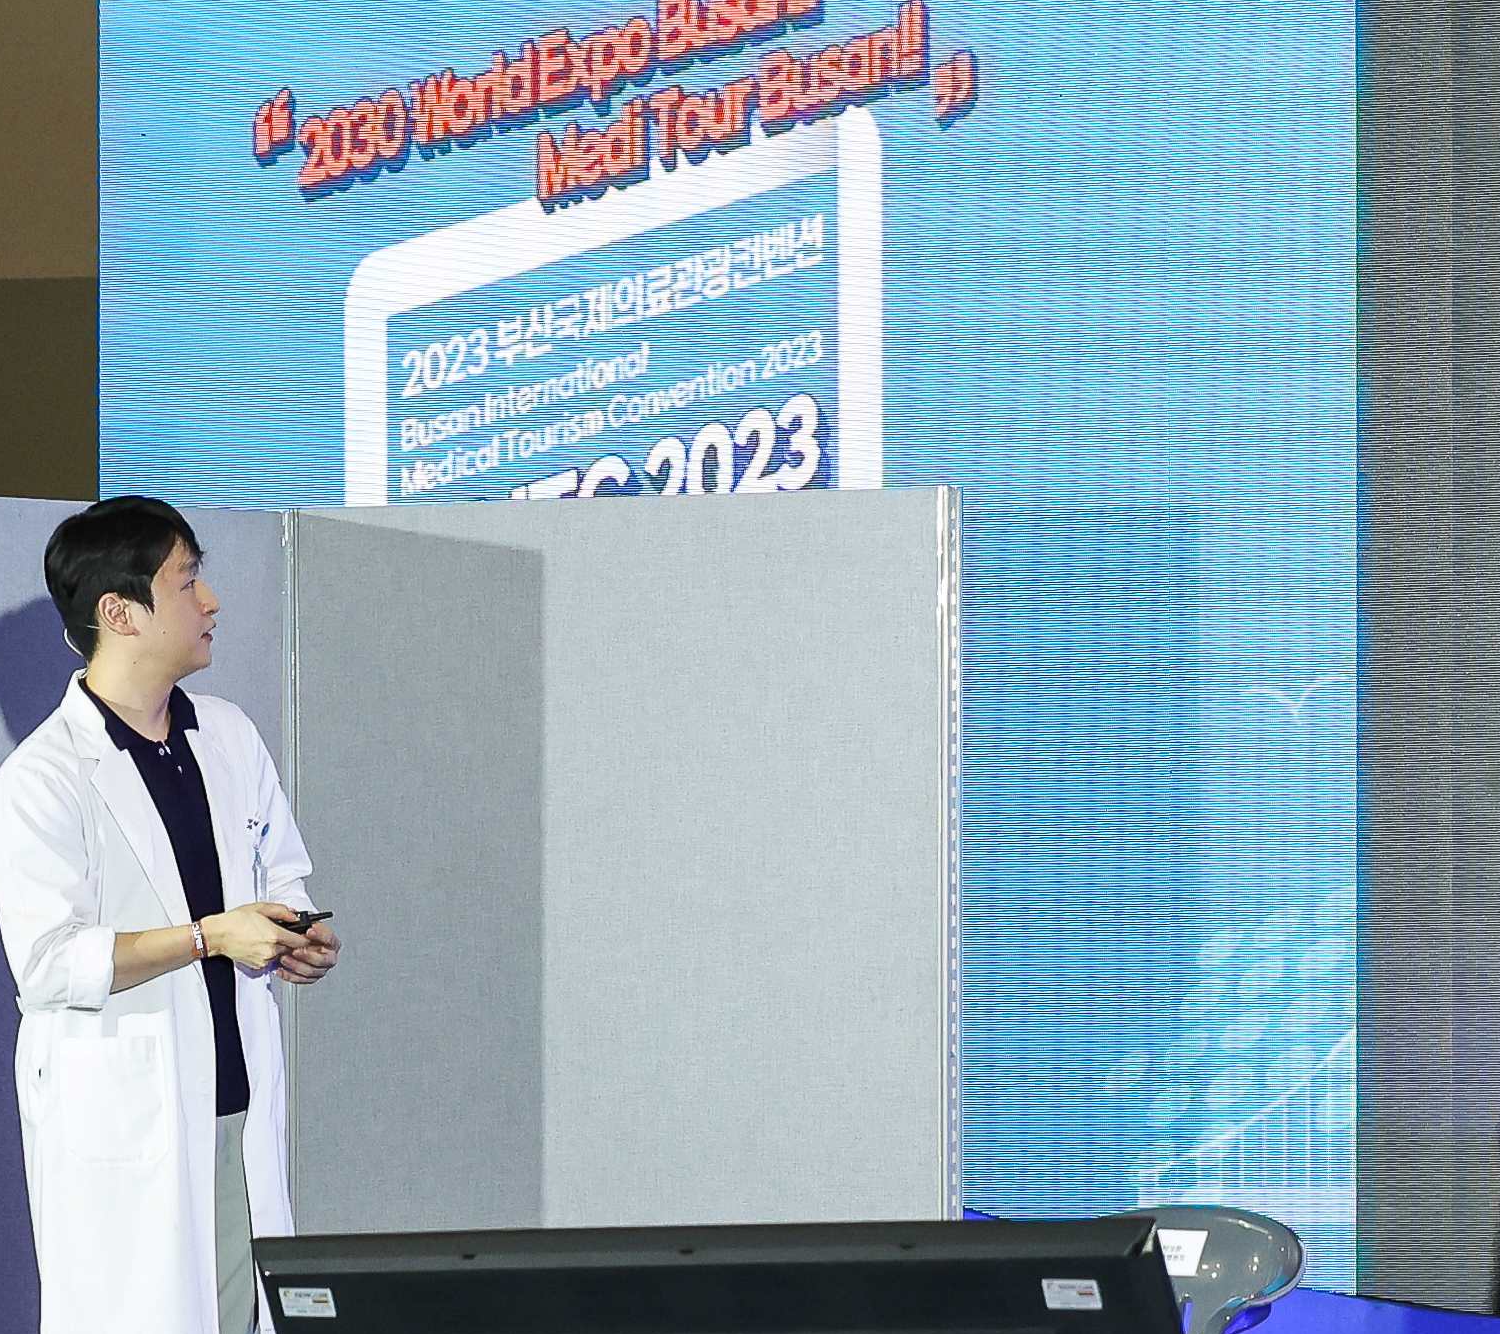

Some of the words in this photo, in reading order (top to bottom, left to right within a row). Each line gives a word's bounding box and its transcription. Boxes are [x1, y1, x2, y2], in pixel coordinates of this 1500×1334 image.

[411, 40, 538, 149] World
[537, 18, 652, 109] Expo
[538, 97, 647, 205] Medi
[650, 78, 752, 160] Tour
[401, 329, 490, 398] 2023
[401, 404, 482, 451] Busan
[484, 340, 650, 423] International
[401, 444, 500, 497] Medical
[503, 407, 605, 460] Tourism
[607, 360, 758, 427] Convention
[761, 330, 822, 380] 2023
